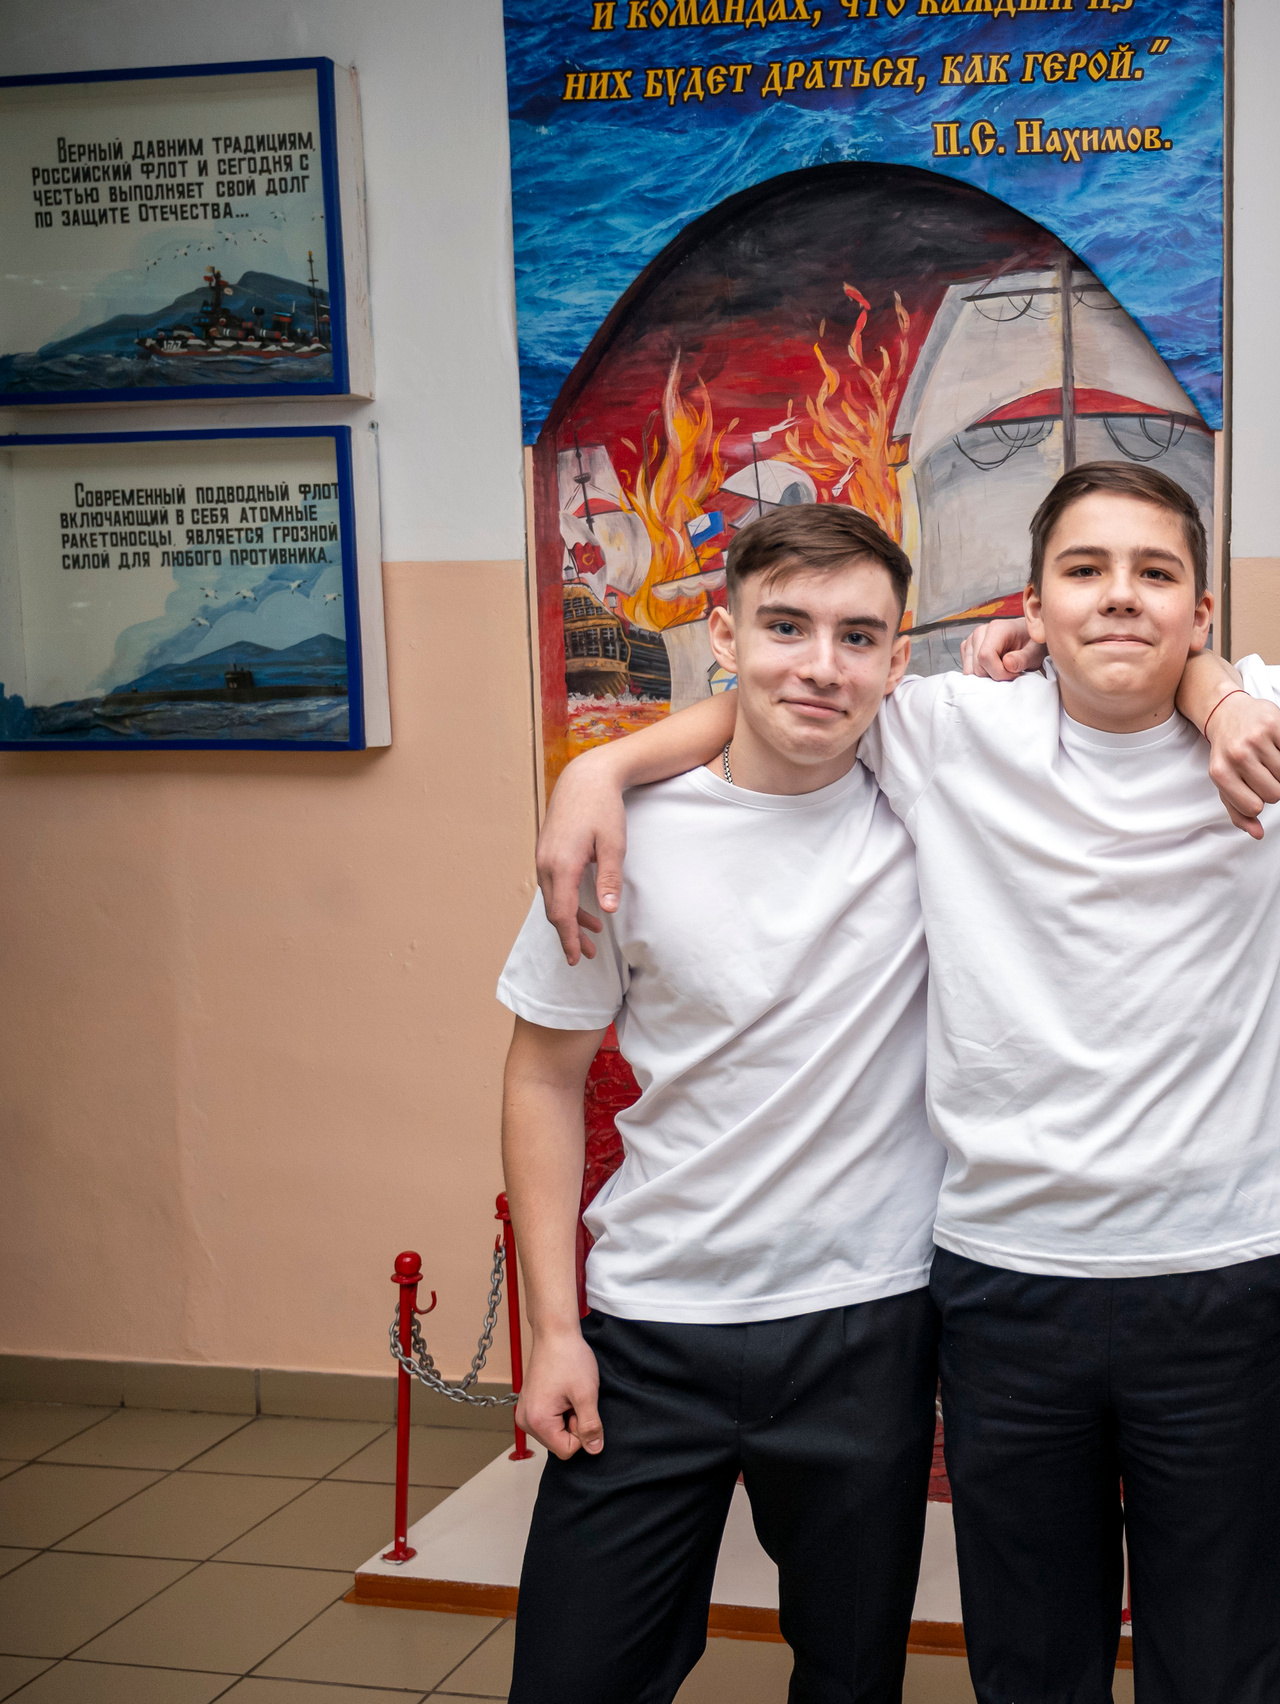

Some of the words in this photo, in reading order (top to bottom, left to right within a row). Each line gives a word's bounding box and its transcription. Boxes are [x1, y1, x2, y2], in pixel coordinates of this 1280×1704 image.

[563, 70, 633, 100] НИХ
[644, 64, 752, 106] БУДЕТ
[761, 56, 926, 98] ДРАТЬСЯ,
[940, 54, 1009, 84] КАК
[132, 138, 203, 161] ДАВНИМ
[212, 132, 316, 155] ТРАДИЦИЯМ,
[933, 119, 1005, 156] П.С.
[1015, 120, 1172, 162] Нахимов.
[141, 160, 188, 180] ФЛОТ
[198, 160, 208, 177] И
[218, 154, 293, 176] СЕГОДНЯ
[299, 154, 309, 171] С
[33, 187, 100, 207] ЧЕСТЬЮ
[109, 182, 204, 203] ВЫПОЛНЯЕТ
[216, 175, 256, 198] СВОЙ
[266, 175, 309, 197] ДОЛГ
[35, 211, 53, 228] ПО
[62, 206, 130, 227] ЗАЩИТЕ
[196, 481, 290, 505] ПОДВОДНЫЙ
[298, 482, 339, 501] ФЛОТ
[60, 506, 169, 529] ВКЛЮЧАЮЩИЙ
[176, 508, 185, 525] В
[191, 507, 229, 525] СЕБЯ
[240, 504, 318, 524] АТОМНЫЕ
[186, 526, 264, 546] ЯВЛЯЕТСЯ
[273, 521, 339, 543] ГРОЗНОЙ
[62, 549, 110, 570] СИЛОЙ
[118, 551, 151, 570] ДЛЯ
[161, 549, 222, 568] ЛЮБОГО
[230, 546, 333, 566] ПРОТИВНИКА.
